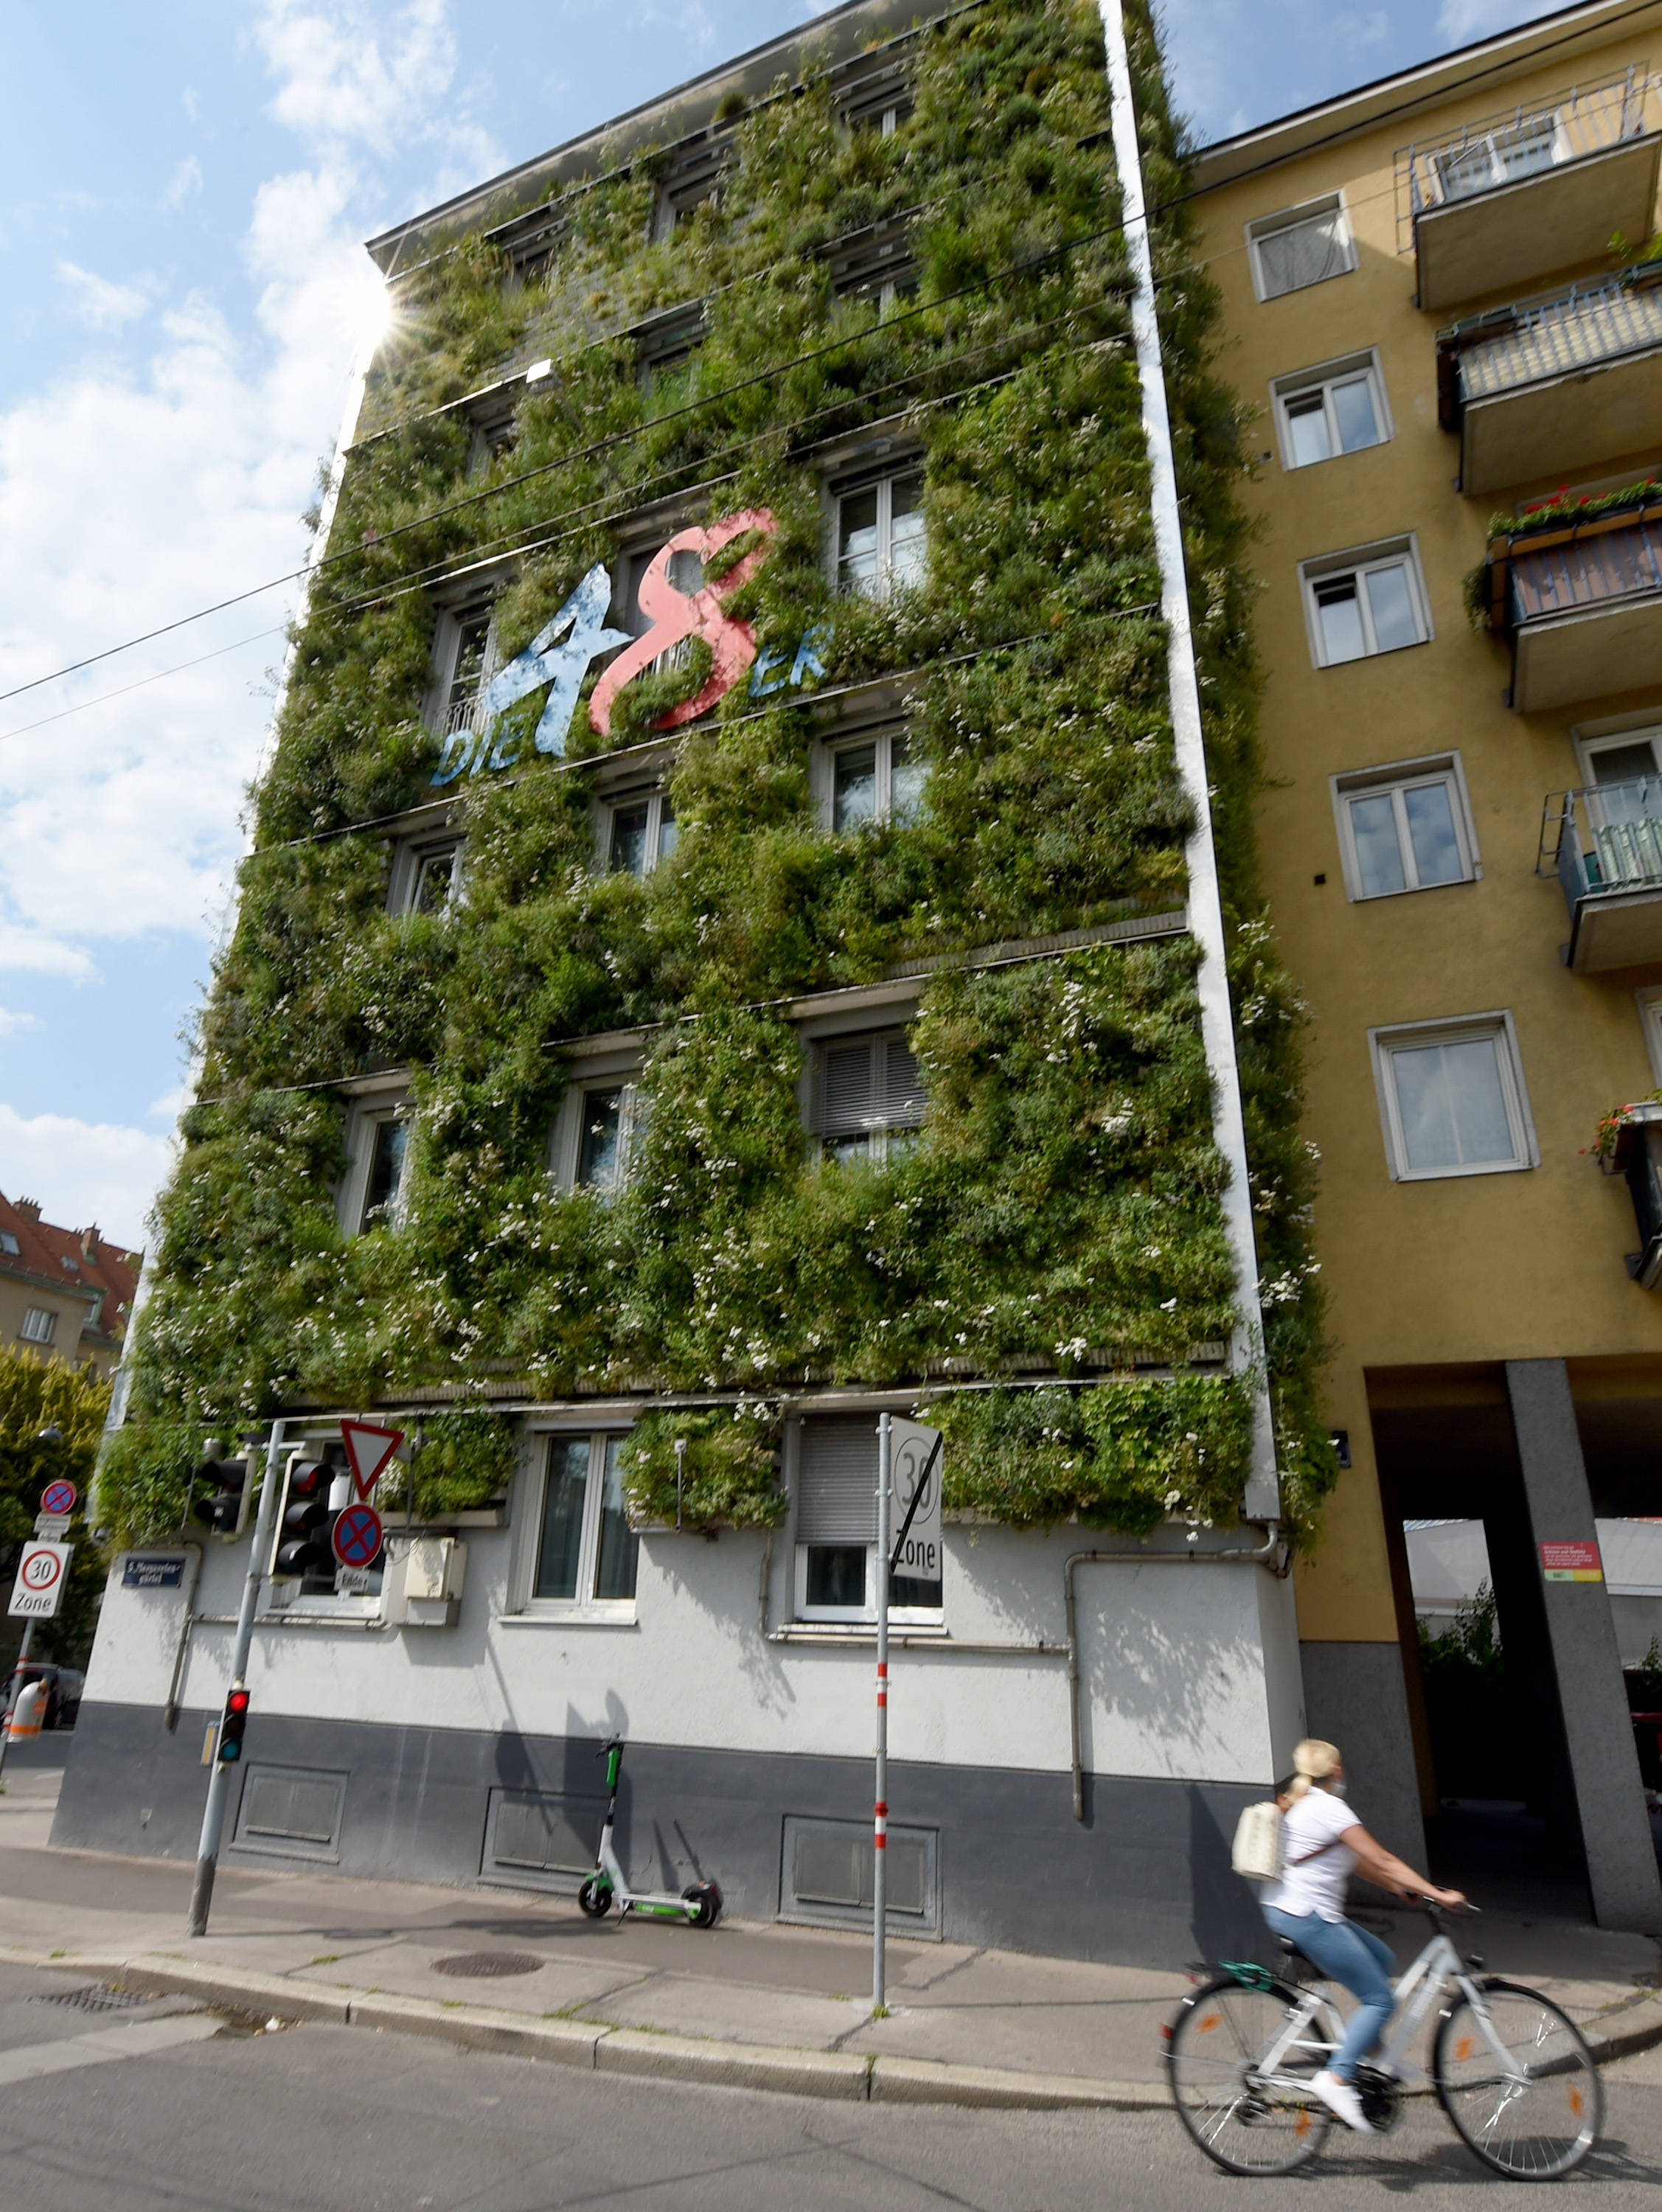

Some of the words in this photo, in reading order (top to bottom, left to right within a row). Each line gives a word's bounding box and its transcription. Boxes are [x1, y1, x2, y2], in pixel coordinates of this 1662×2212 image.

[429, 712, 524, 787] DIE
[902, 1452, 932, 1509] 30
[894, 1528, 935, 1568] Zone
[29, 1559, 52, 1581] 30
[14, 1593, 52, 1612] Zone
